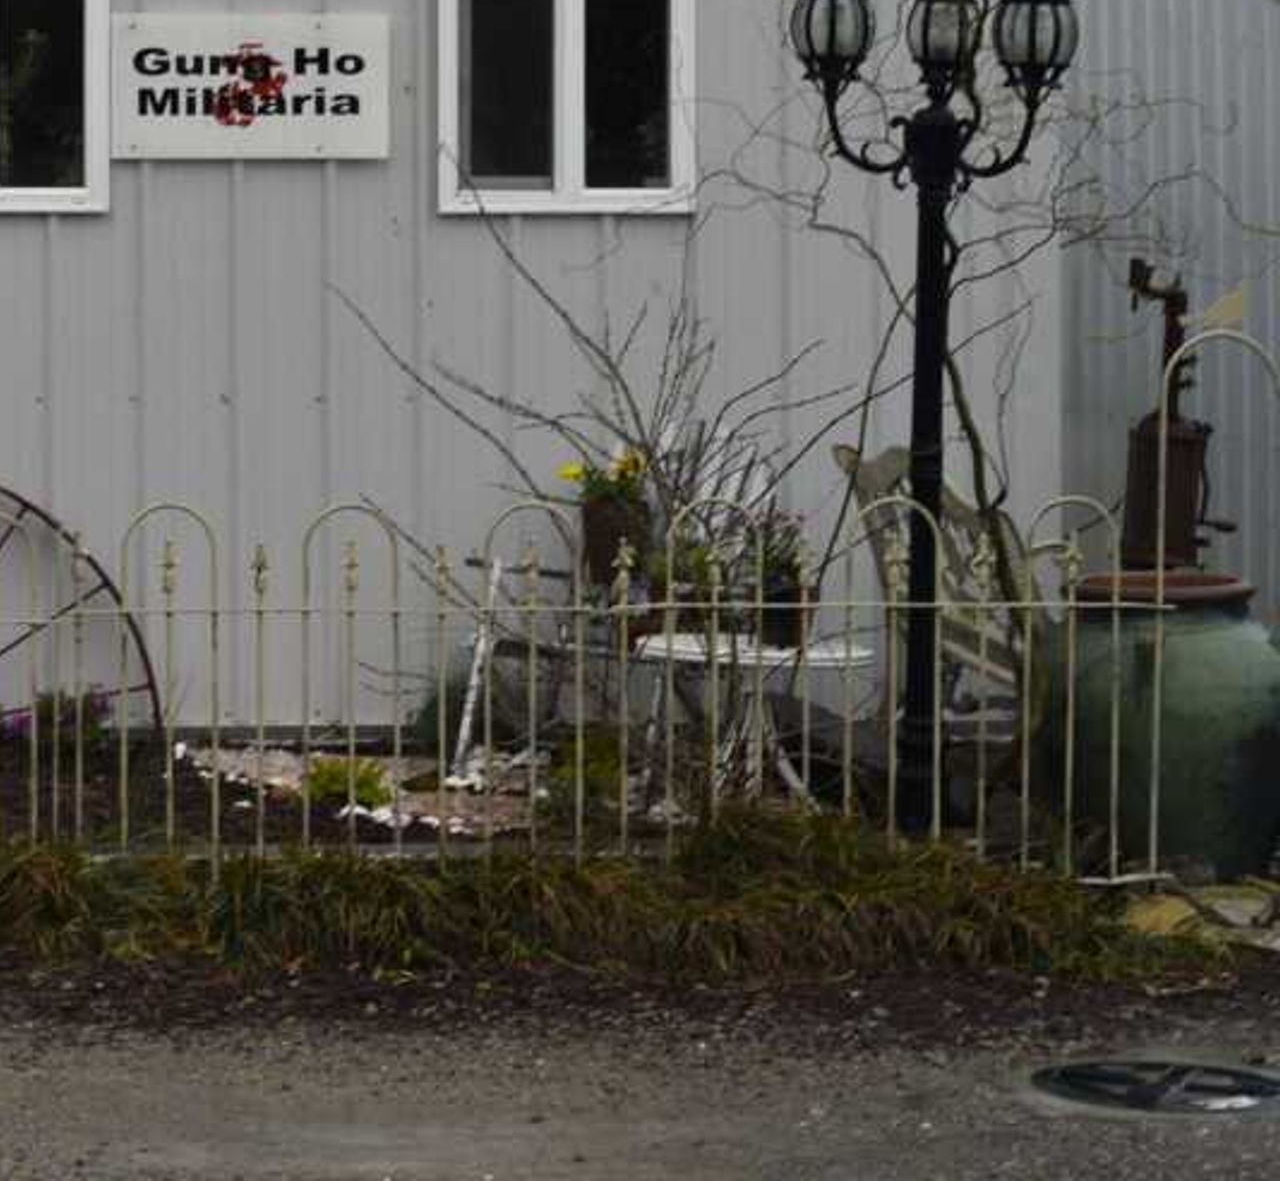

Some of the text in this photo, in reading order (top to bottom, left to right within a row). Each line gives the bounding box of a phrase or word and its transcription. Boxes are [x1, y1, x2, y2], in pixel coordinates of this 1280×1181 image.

[132, 47, 366, 79] Gun Ho
[137, 86, 361, 117] Milaria
